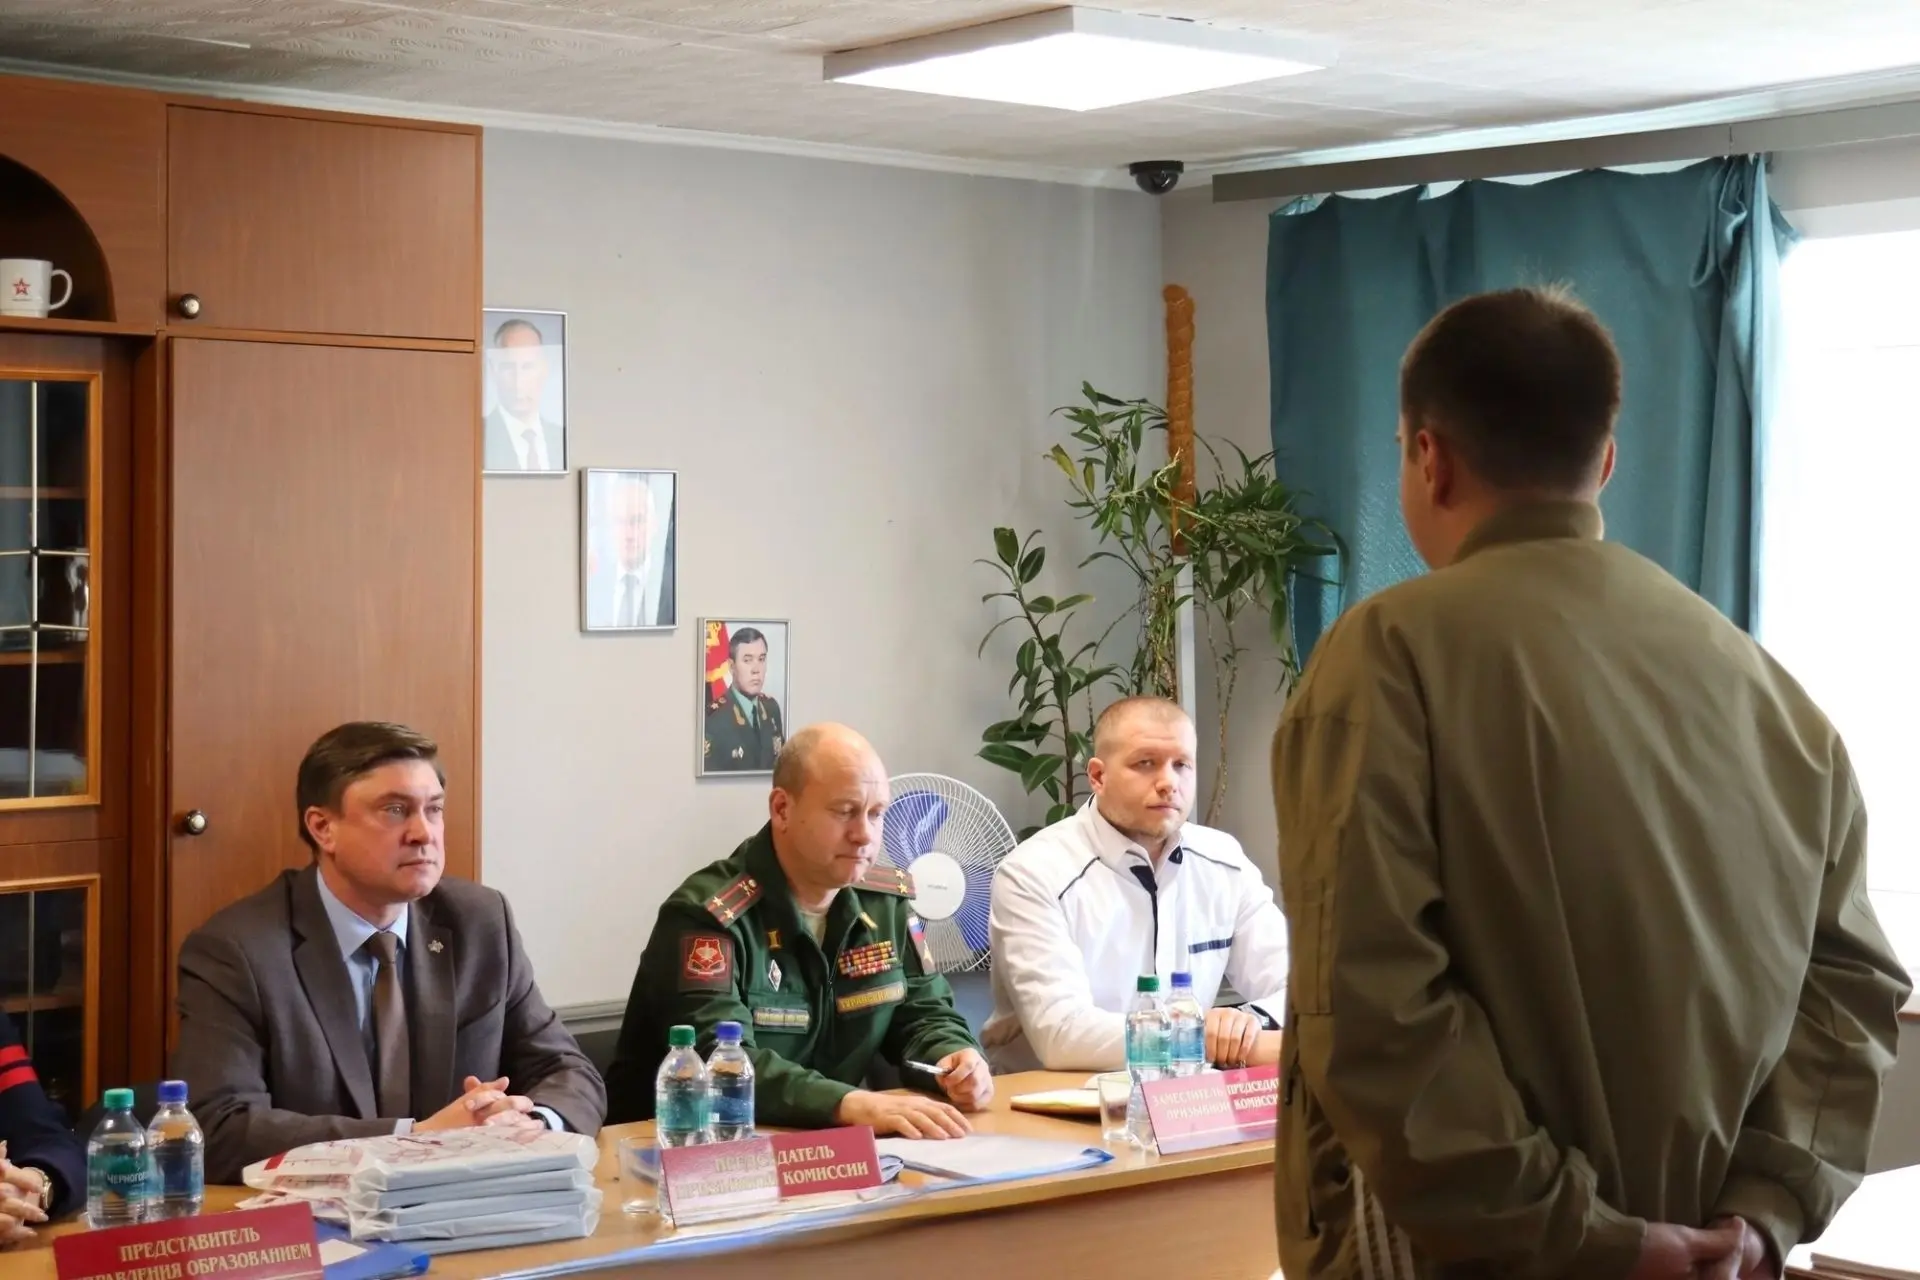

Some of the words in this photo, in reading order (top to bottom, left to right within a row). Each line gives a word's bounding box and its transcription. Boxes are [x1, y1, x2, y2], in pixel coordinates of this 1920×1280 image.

[1234, 1093, 1278, 1111] КОМИССИ
[714, 1144, 836, 1173] ПРЕДСДАТЕЛЬ
[782, 1161, 869, 1187] КОМИССИИ
[119, 1226, 261, 1262] ПРЕДСТАВИТЕЛЬ
[187, 1242, 312, 1275] ОБРАЗОВАНИЕМ
